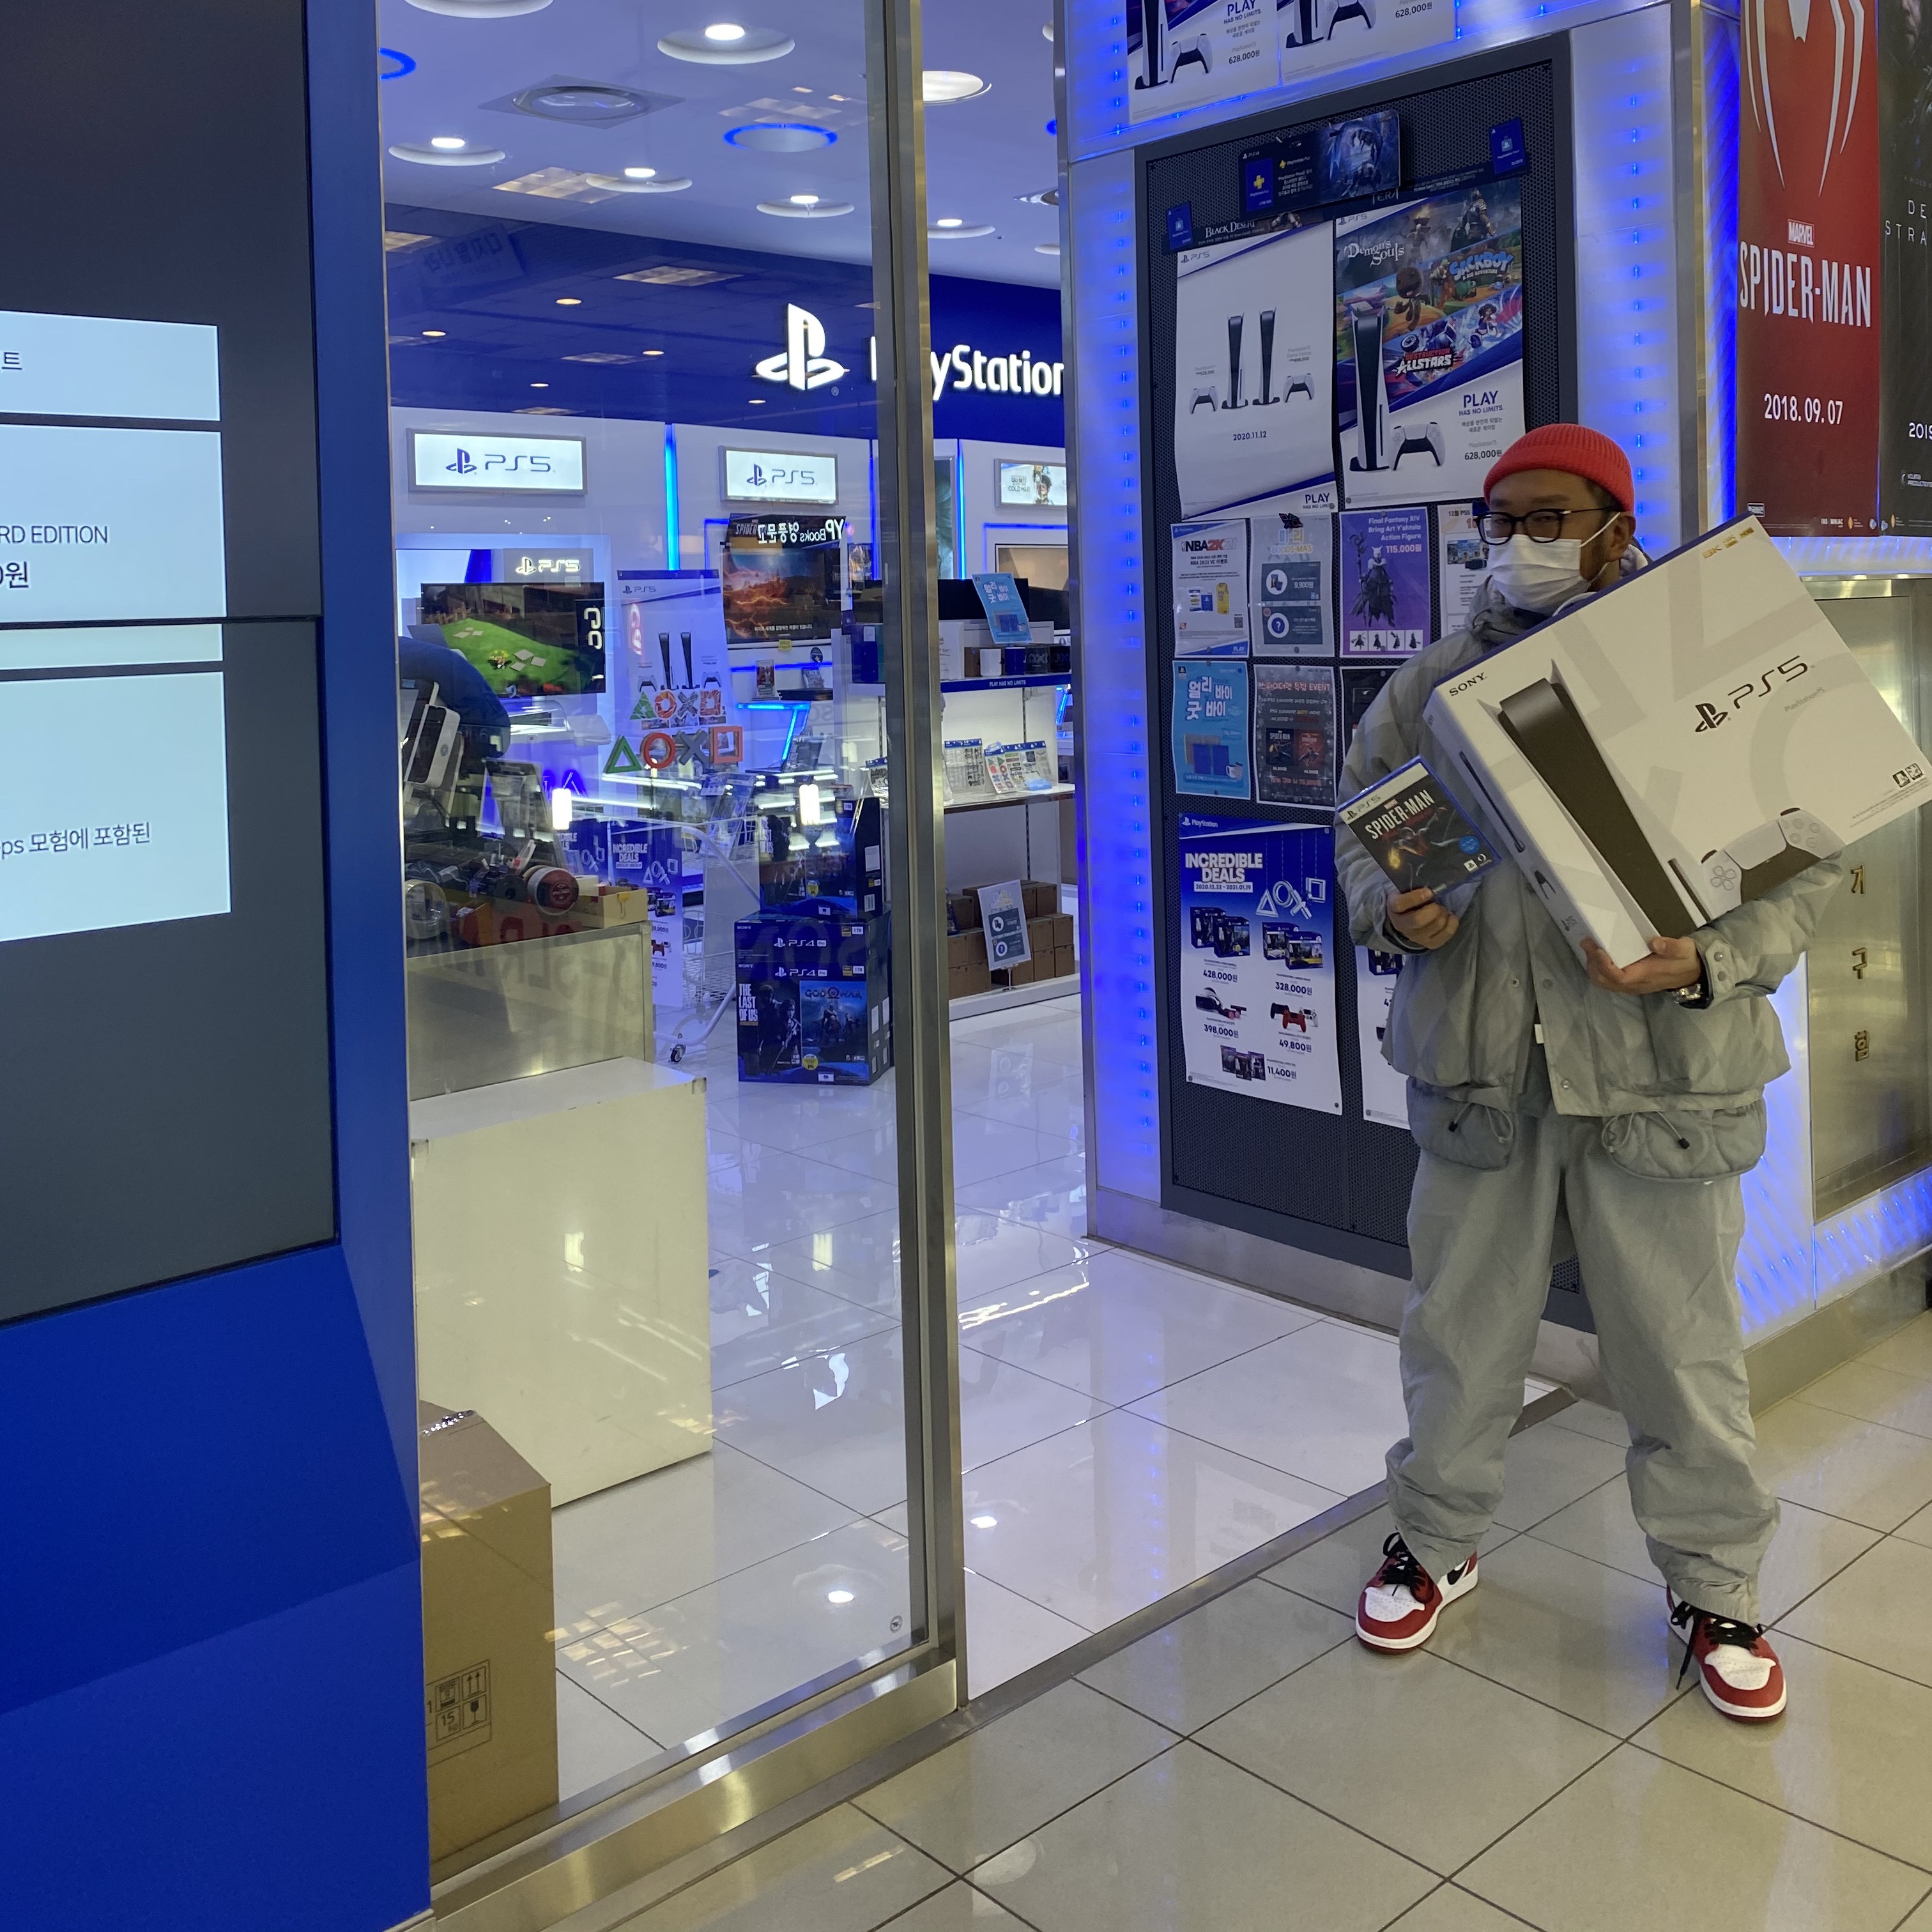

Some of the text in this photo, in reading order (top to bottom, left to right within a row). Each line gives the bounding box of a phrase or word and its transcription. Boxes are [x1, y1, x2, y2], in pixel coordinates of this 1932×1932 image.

[1227, 0, 1255, 17] PLAY
[1243, 9, 1261, 19] LIMITS
[1395, 2, 1432, 19] 628,000원
[1229, 49, 1260, 65] 628,000원
[1372, 187, 1399, 205] TERA
[1347, 213, 1367, 222] PS5
[1788, 219, 1814, 247] MARVEL
[1190, 251, 1210, 261] PS5
[1739, 240, 1872, 328] SPIDER-MAN
[0, 351, 23, 371] 트
[1463, 390, 1499, 408] PLAY
[1233, 431, 1267, 441] 2020.11.12
[1464, 449, 1503, 460] 628,000원
[484, 454, 551, 473] PS5
[772, 468, 816, 486] PS5
[1305, 493, 1330, 503] PLAY
[1384, 516, 1408, 525] Fantasy
[31, 525, 108, 544] EDITION
[1401, 533, 1422, 541] Figure
[1270, 544, 1313, 554] GOODS-MAS
[539, 559, 581, 573] PS5
[1188, 676, 1232, 700] 얼리 바이
[1308, 683, 1330, 691] EVENT
[1448, 671, 1486, 697] SONY
[1727, 655, 1809, 710] PS5
[1186, 700, 1226, 721] 굿 바이
[1356, 795, 1381, 813] PS5
[1364, 789, 1436, 839] SPIDER-MAN
[1192, 819, 1218, 828] PlayStation
[0, 821, 151, 860] ps 모험에 포함된
[613, 843, 648, 854] INCREDIBLE
[618, 853, 640, 862] DEALS
[1184, 852, 1263, 869] INCREDIBLE
[1202, 868, 1246, 884] DEALS
[789, 969, 816, 977] PS4
[1203, 969, 1238, 983] 428,000원
[739, 983, 752, 997] THE
[1275, 981, 1312, 996] 328,000원
[739, 995, 756, 1009] LAST
[739, 1008, 758, 1022] OF US
[1204, 1023, 1239, 1039] 398,000원
[1279, 1039, 1312, 1053] 49,800원
[1267, 1065, 1297, 1080] 11,400원
